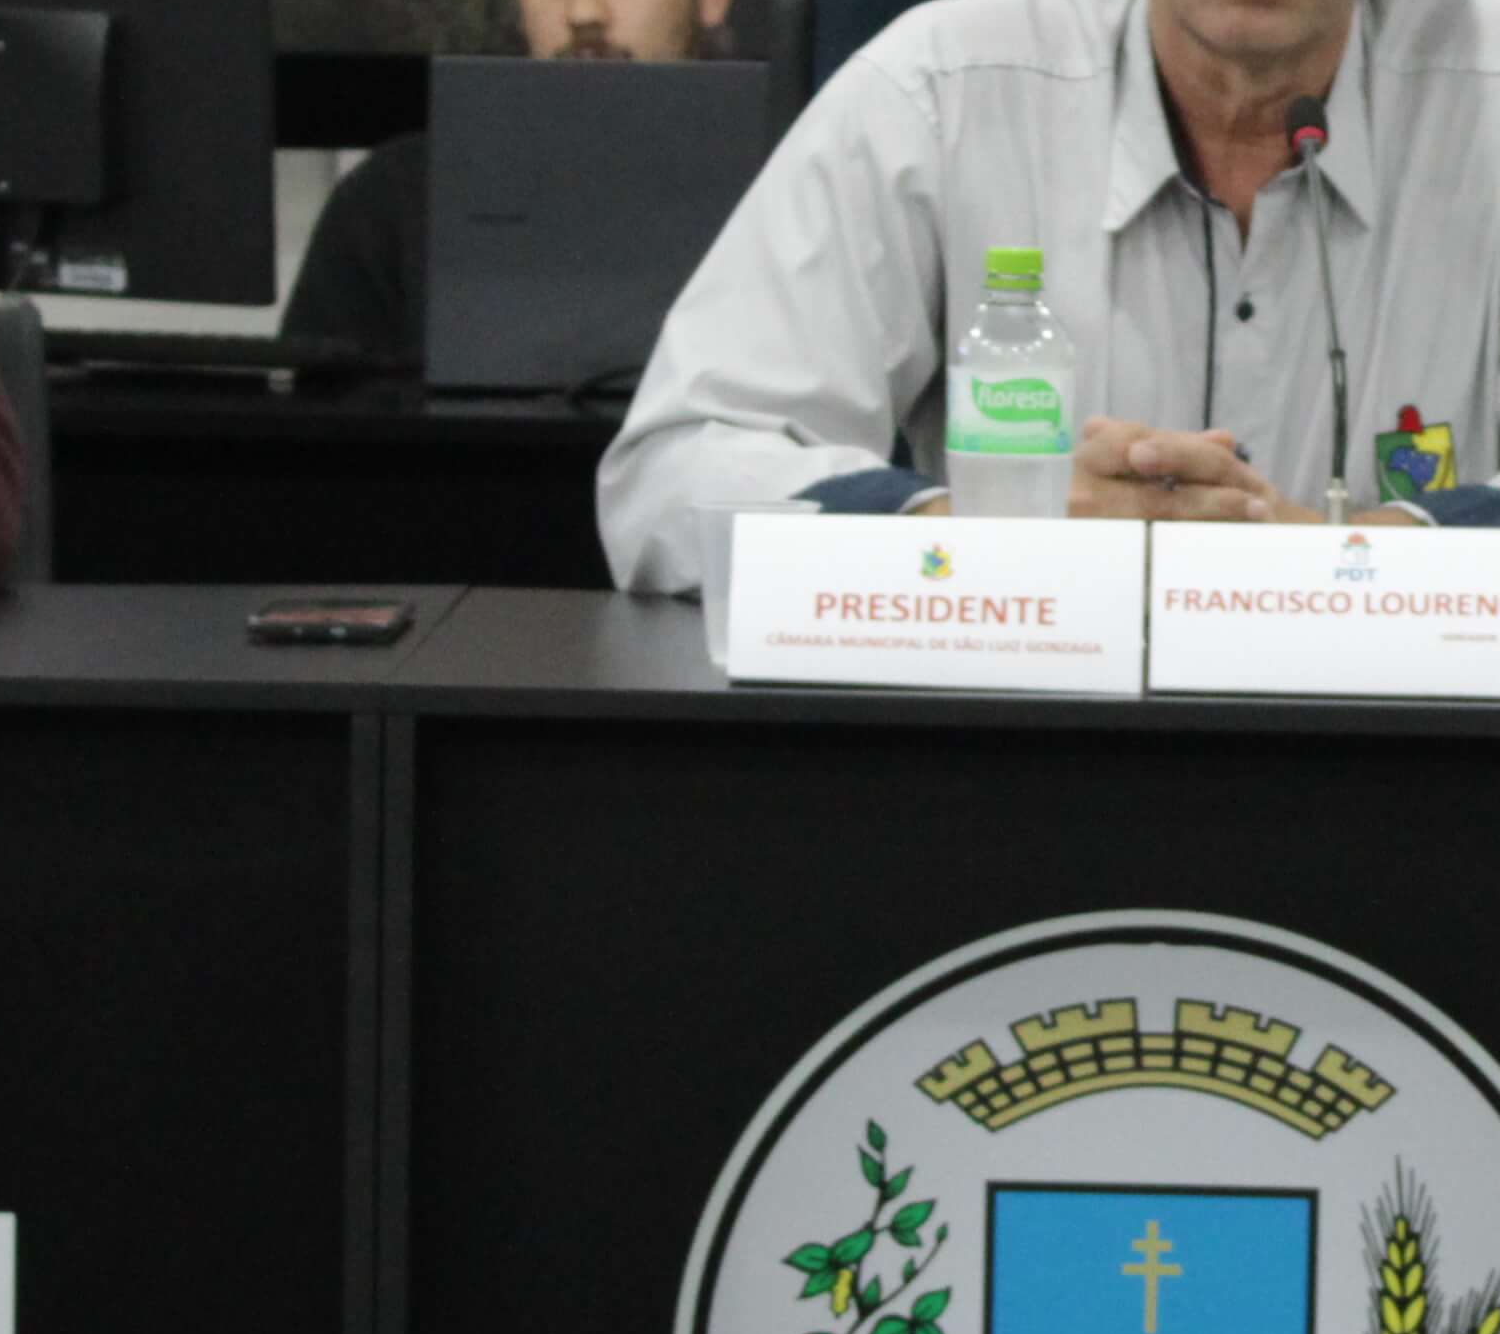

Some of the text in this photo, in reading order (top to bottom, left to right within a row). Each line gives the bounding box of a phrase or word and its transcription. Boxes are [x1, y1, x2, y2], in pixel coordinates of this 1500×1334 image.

[1334, 566, 1378, 582] PDT
[813, 591, 1058, 627] PRESIDENTE
[1164, 588, 1353, 617] FRANCISCO
